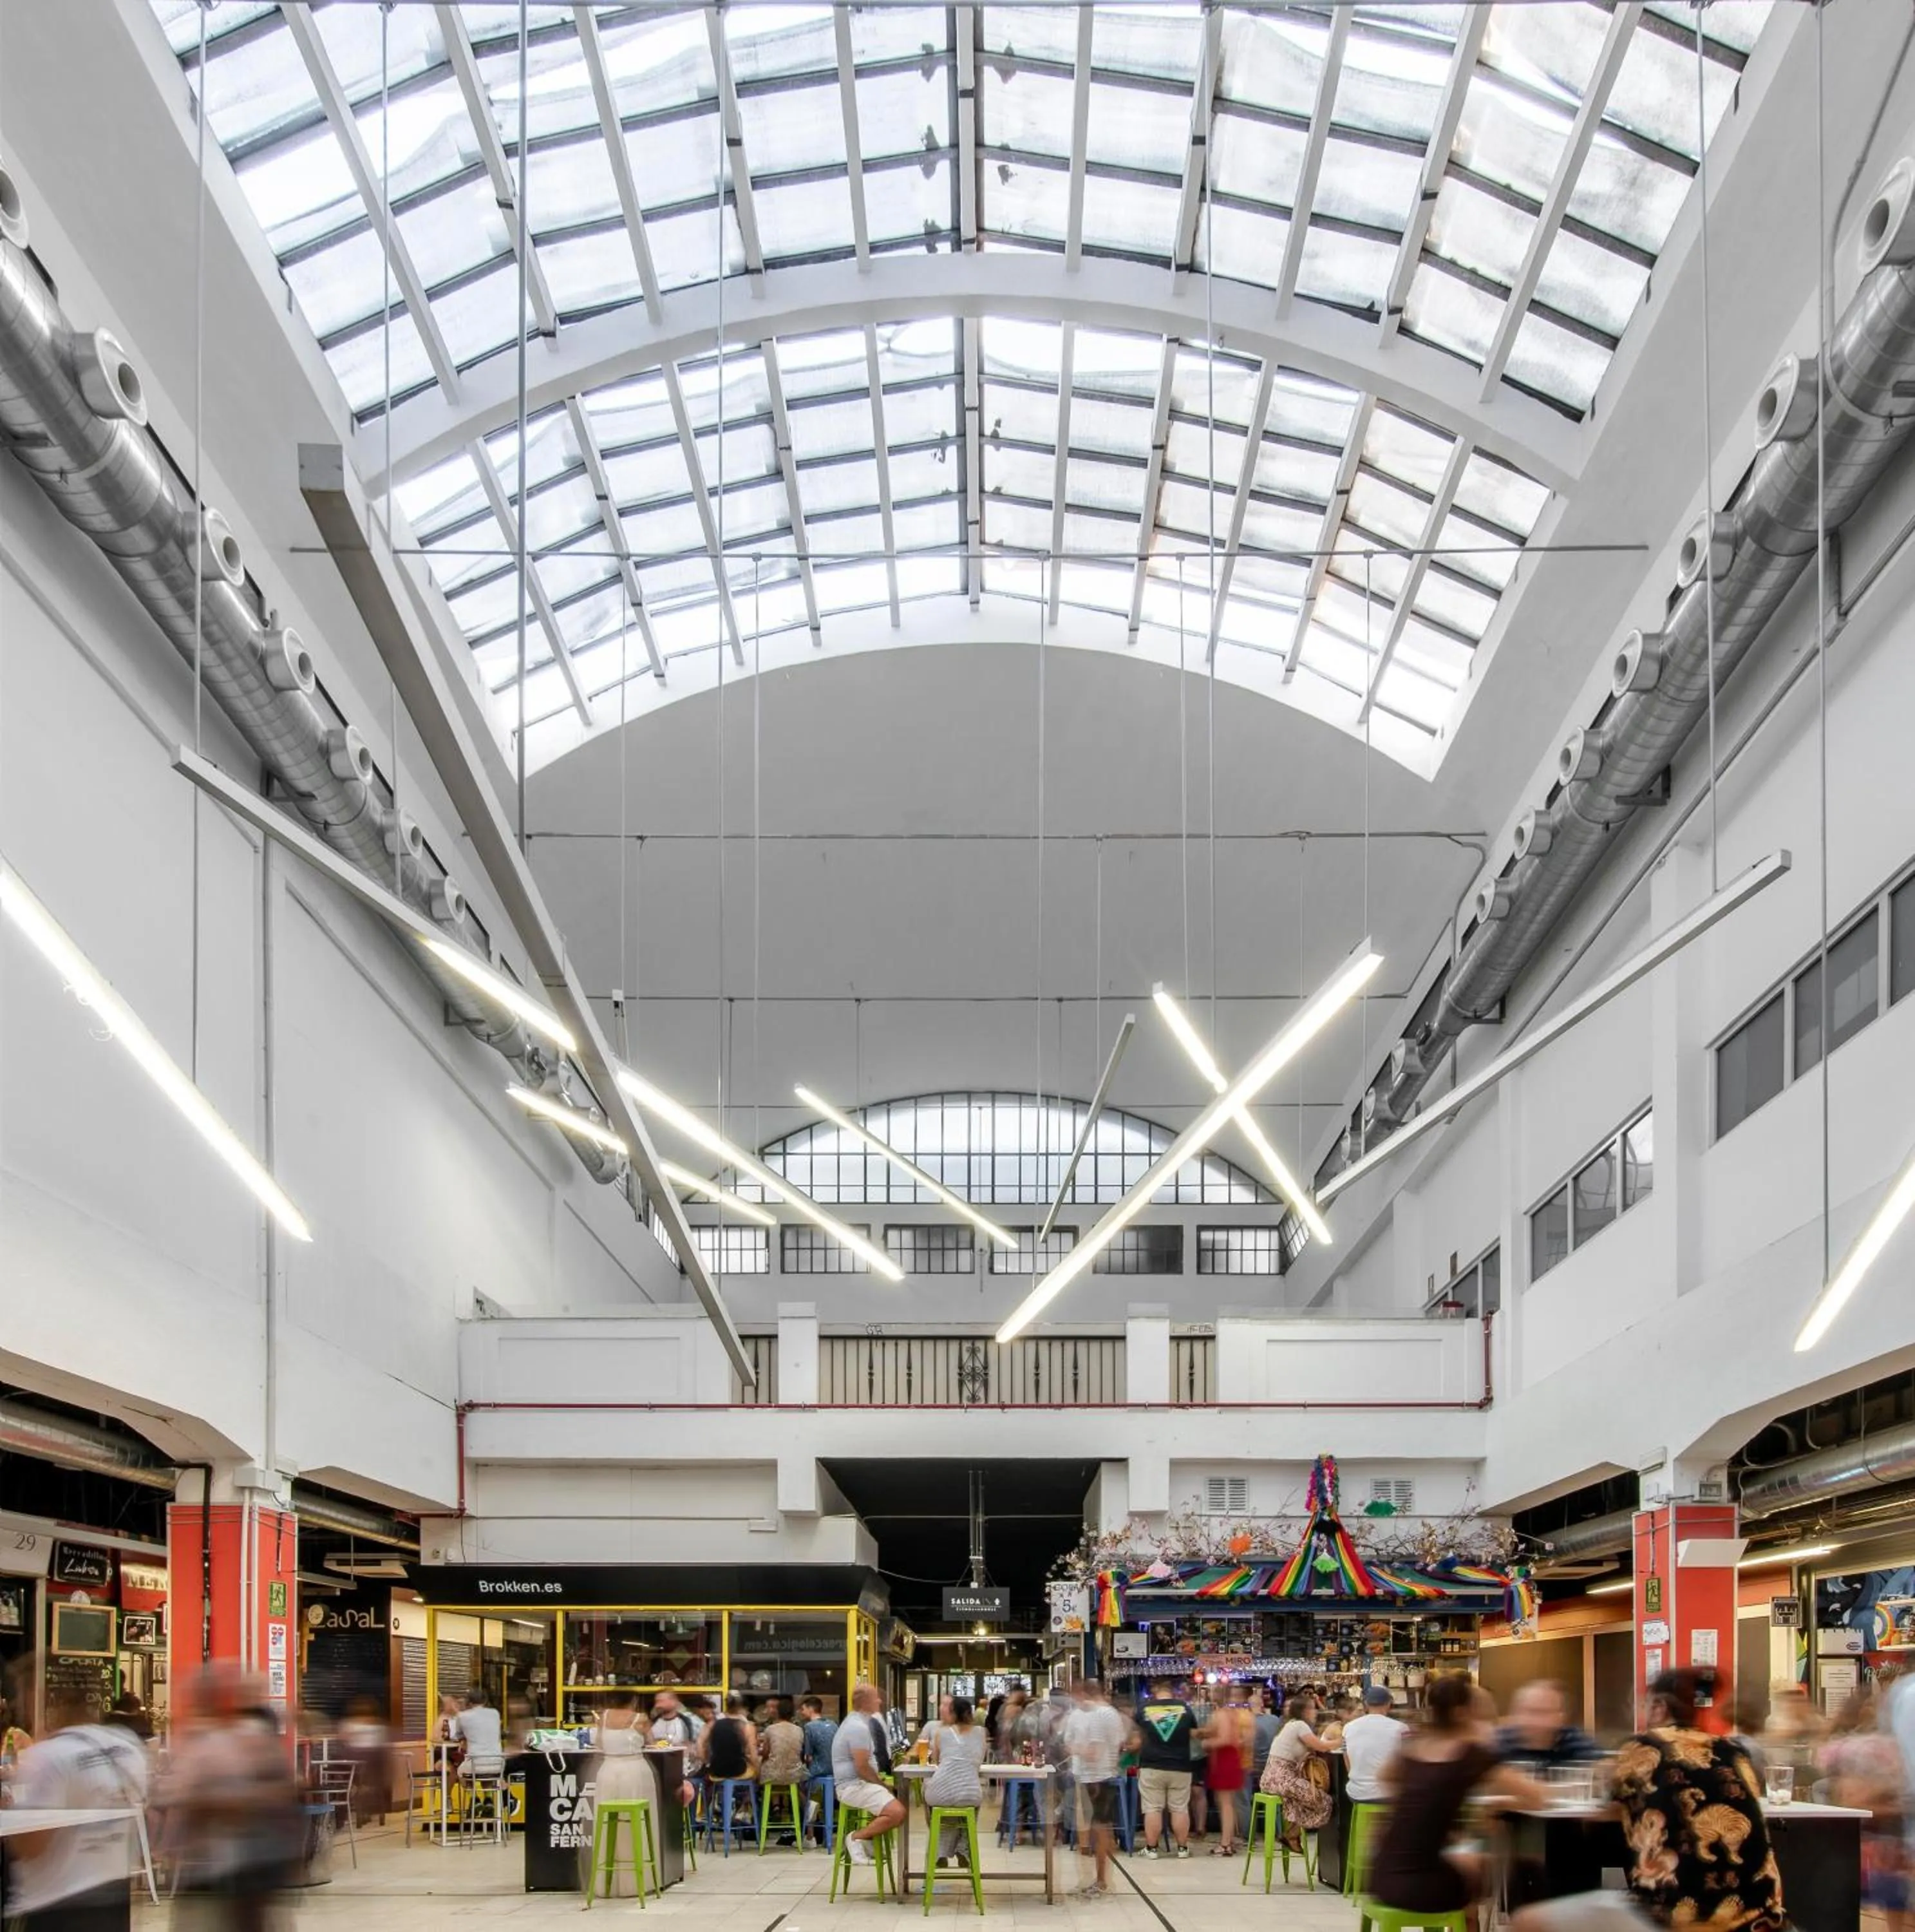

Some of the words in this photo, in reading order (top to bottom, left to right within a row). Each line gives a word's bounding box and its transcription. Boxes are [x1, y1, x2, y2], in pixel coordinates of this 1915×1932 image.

[14, 1534, 36, 1551] 29
[478, 1580, 563, 1593] Brokken.es
[550, 1823, 583, 1835] SAN
